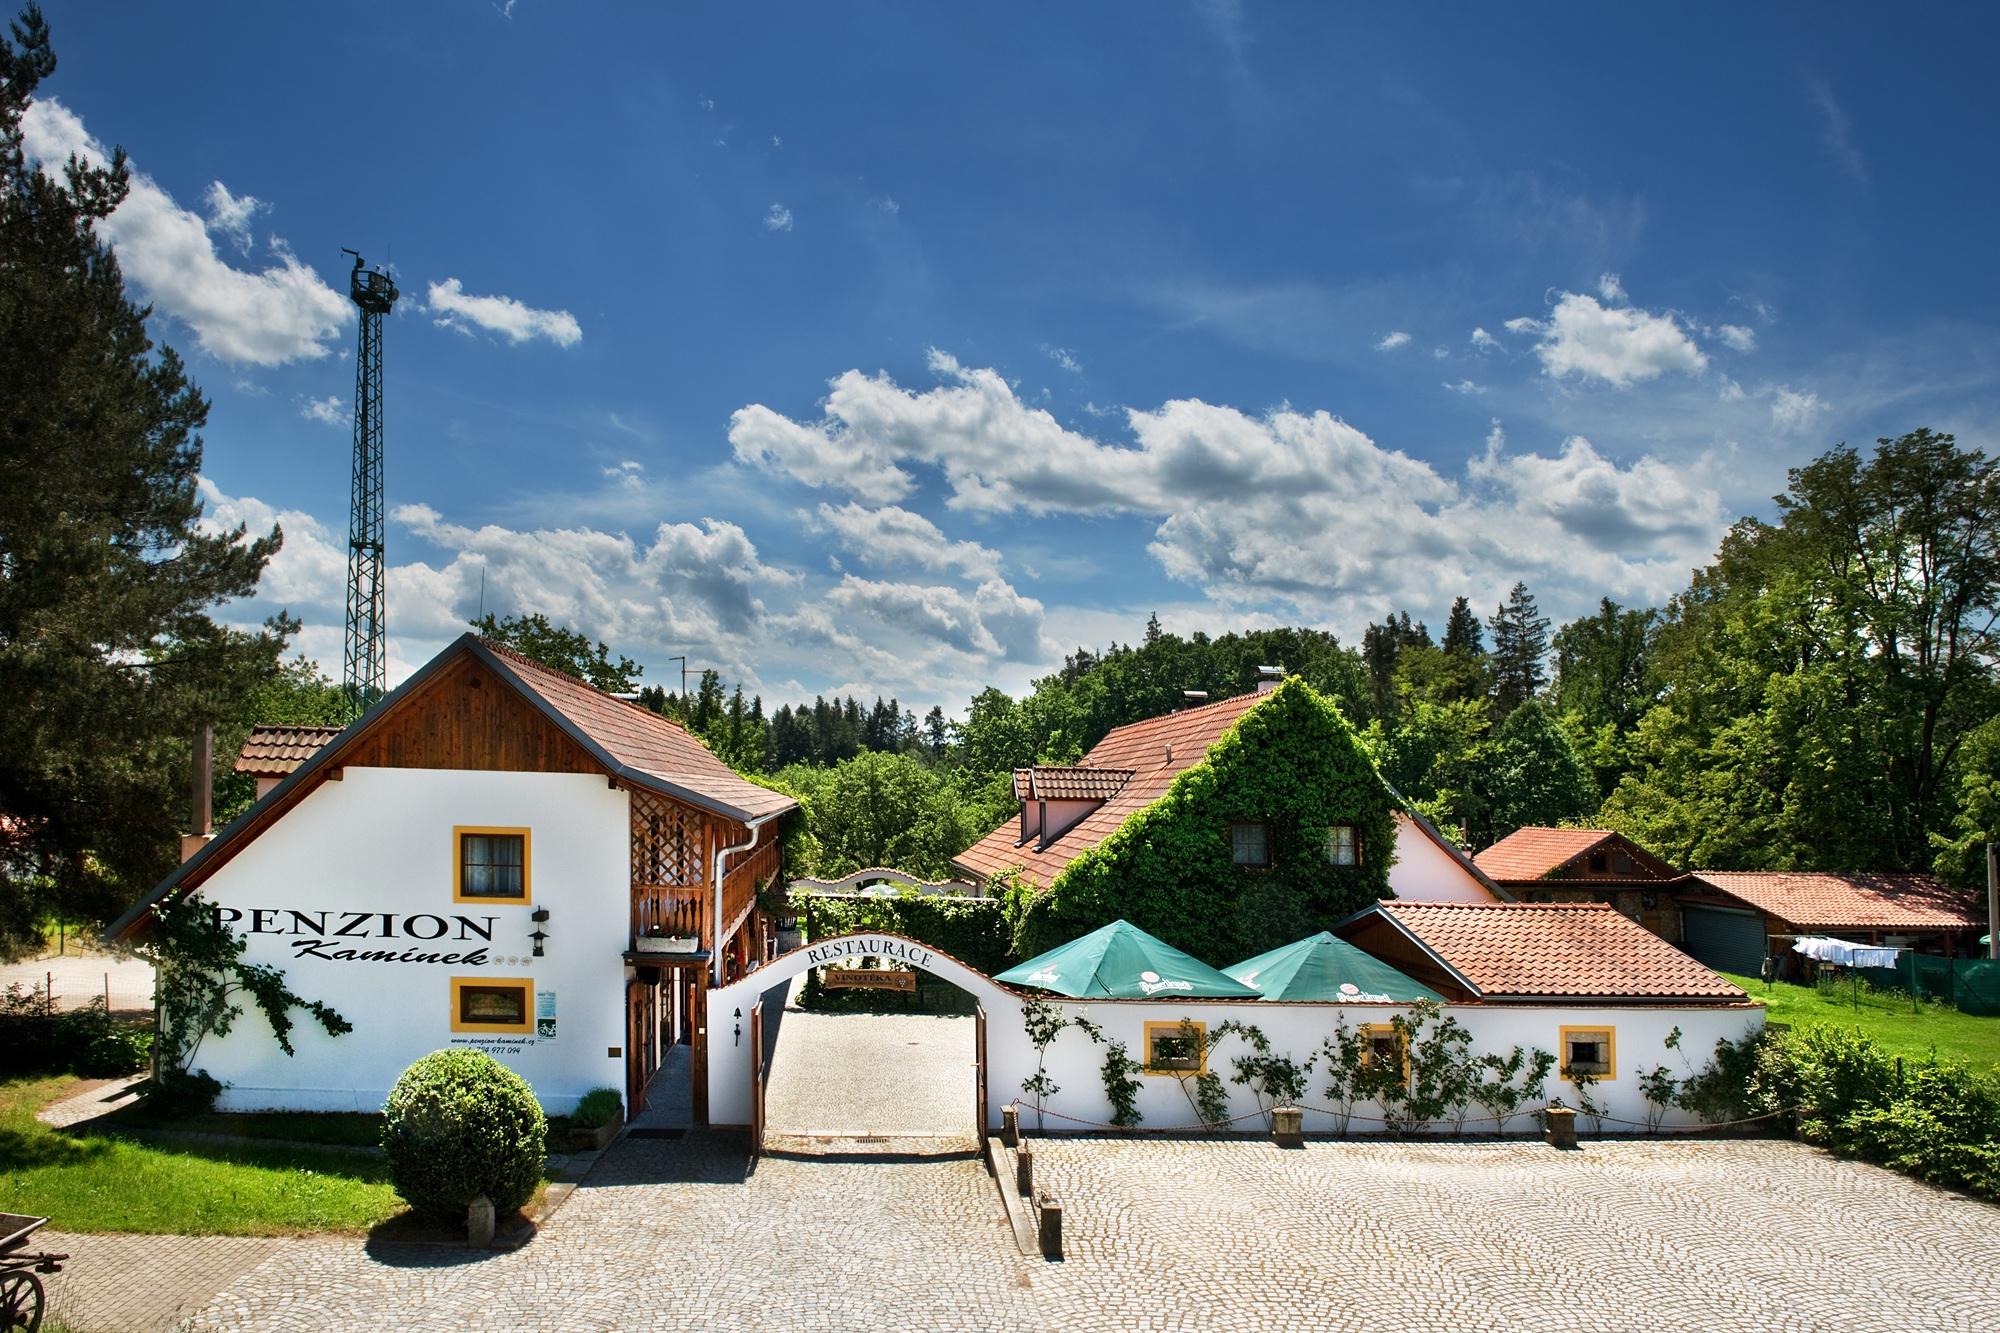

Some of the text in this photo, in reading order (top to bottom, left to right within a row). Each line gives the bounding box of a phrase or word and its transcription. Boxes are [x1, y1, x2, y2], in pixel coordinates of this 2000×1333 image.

[212, 907, 500, 942] PENZION
[291, 939, 489, 966] Kamínek
[808, 940, 933, 967] RESTAURACE
